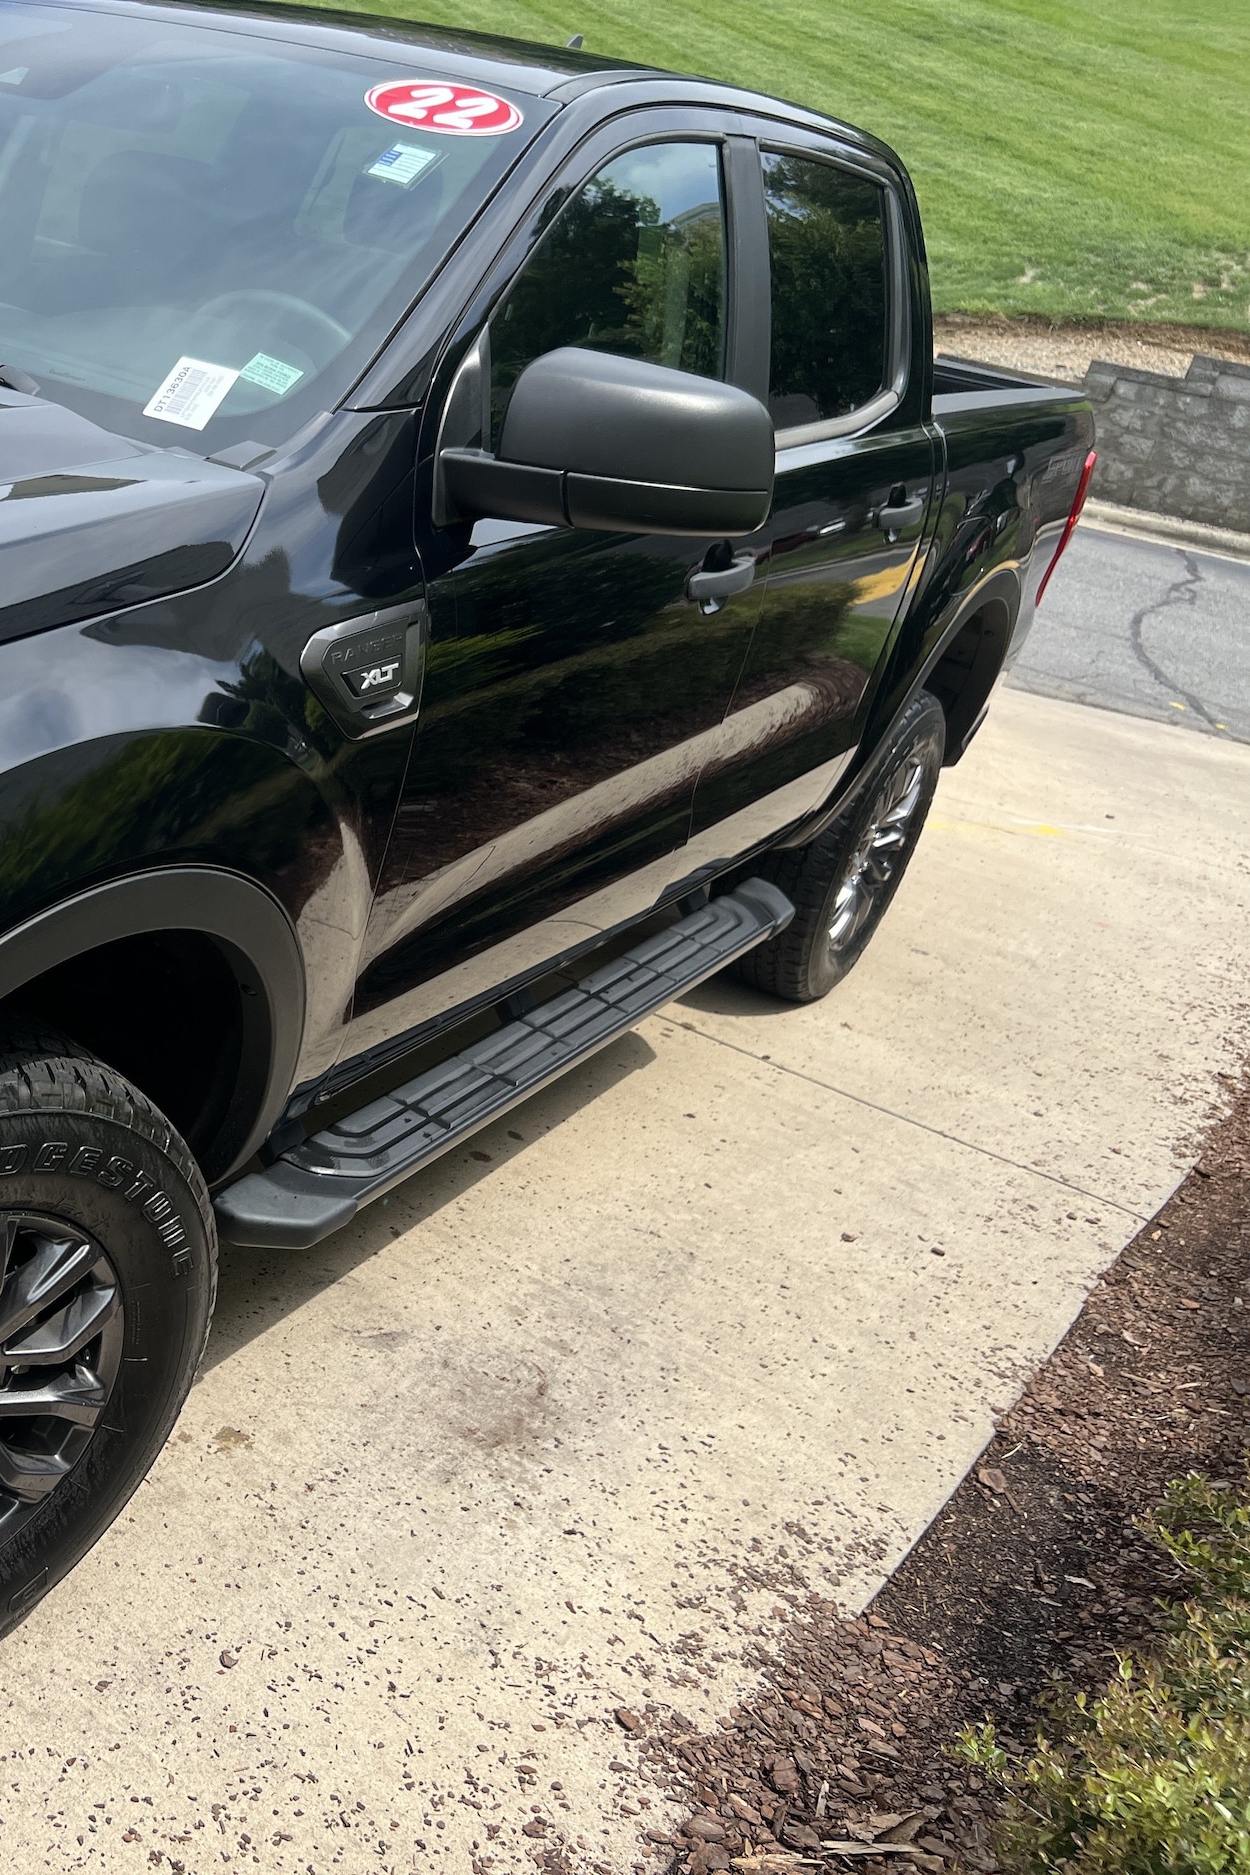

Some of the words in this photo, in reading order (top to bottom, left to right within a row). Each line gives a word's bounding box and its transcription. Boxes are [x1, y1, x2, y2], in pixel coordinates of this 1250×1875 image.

[387, 87, 500, 129] 22
[153, 366, 191, 413] DT13630A
[360, 662, 400, 690] XLT
